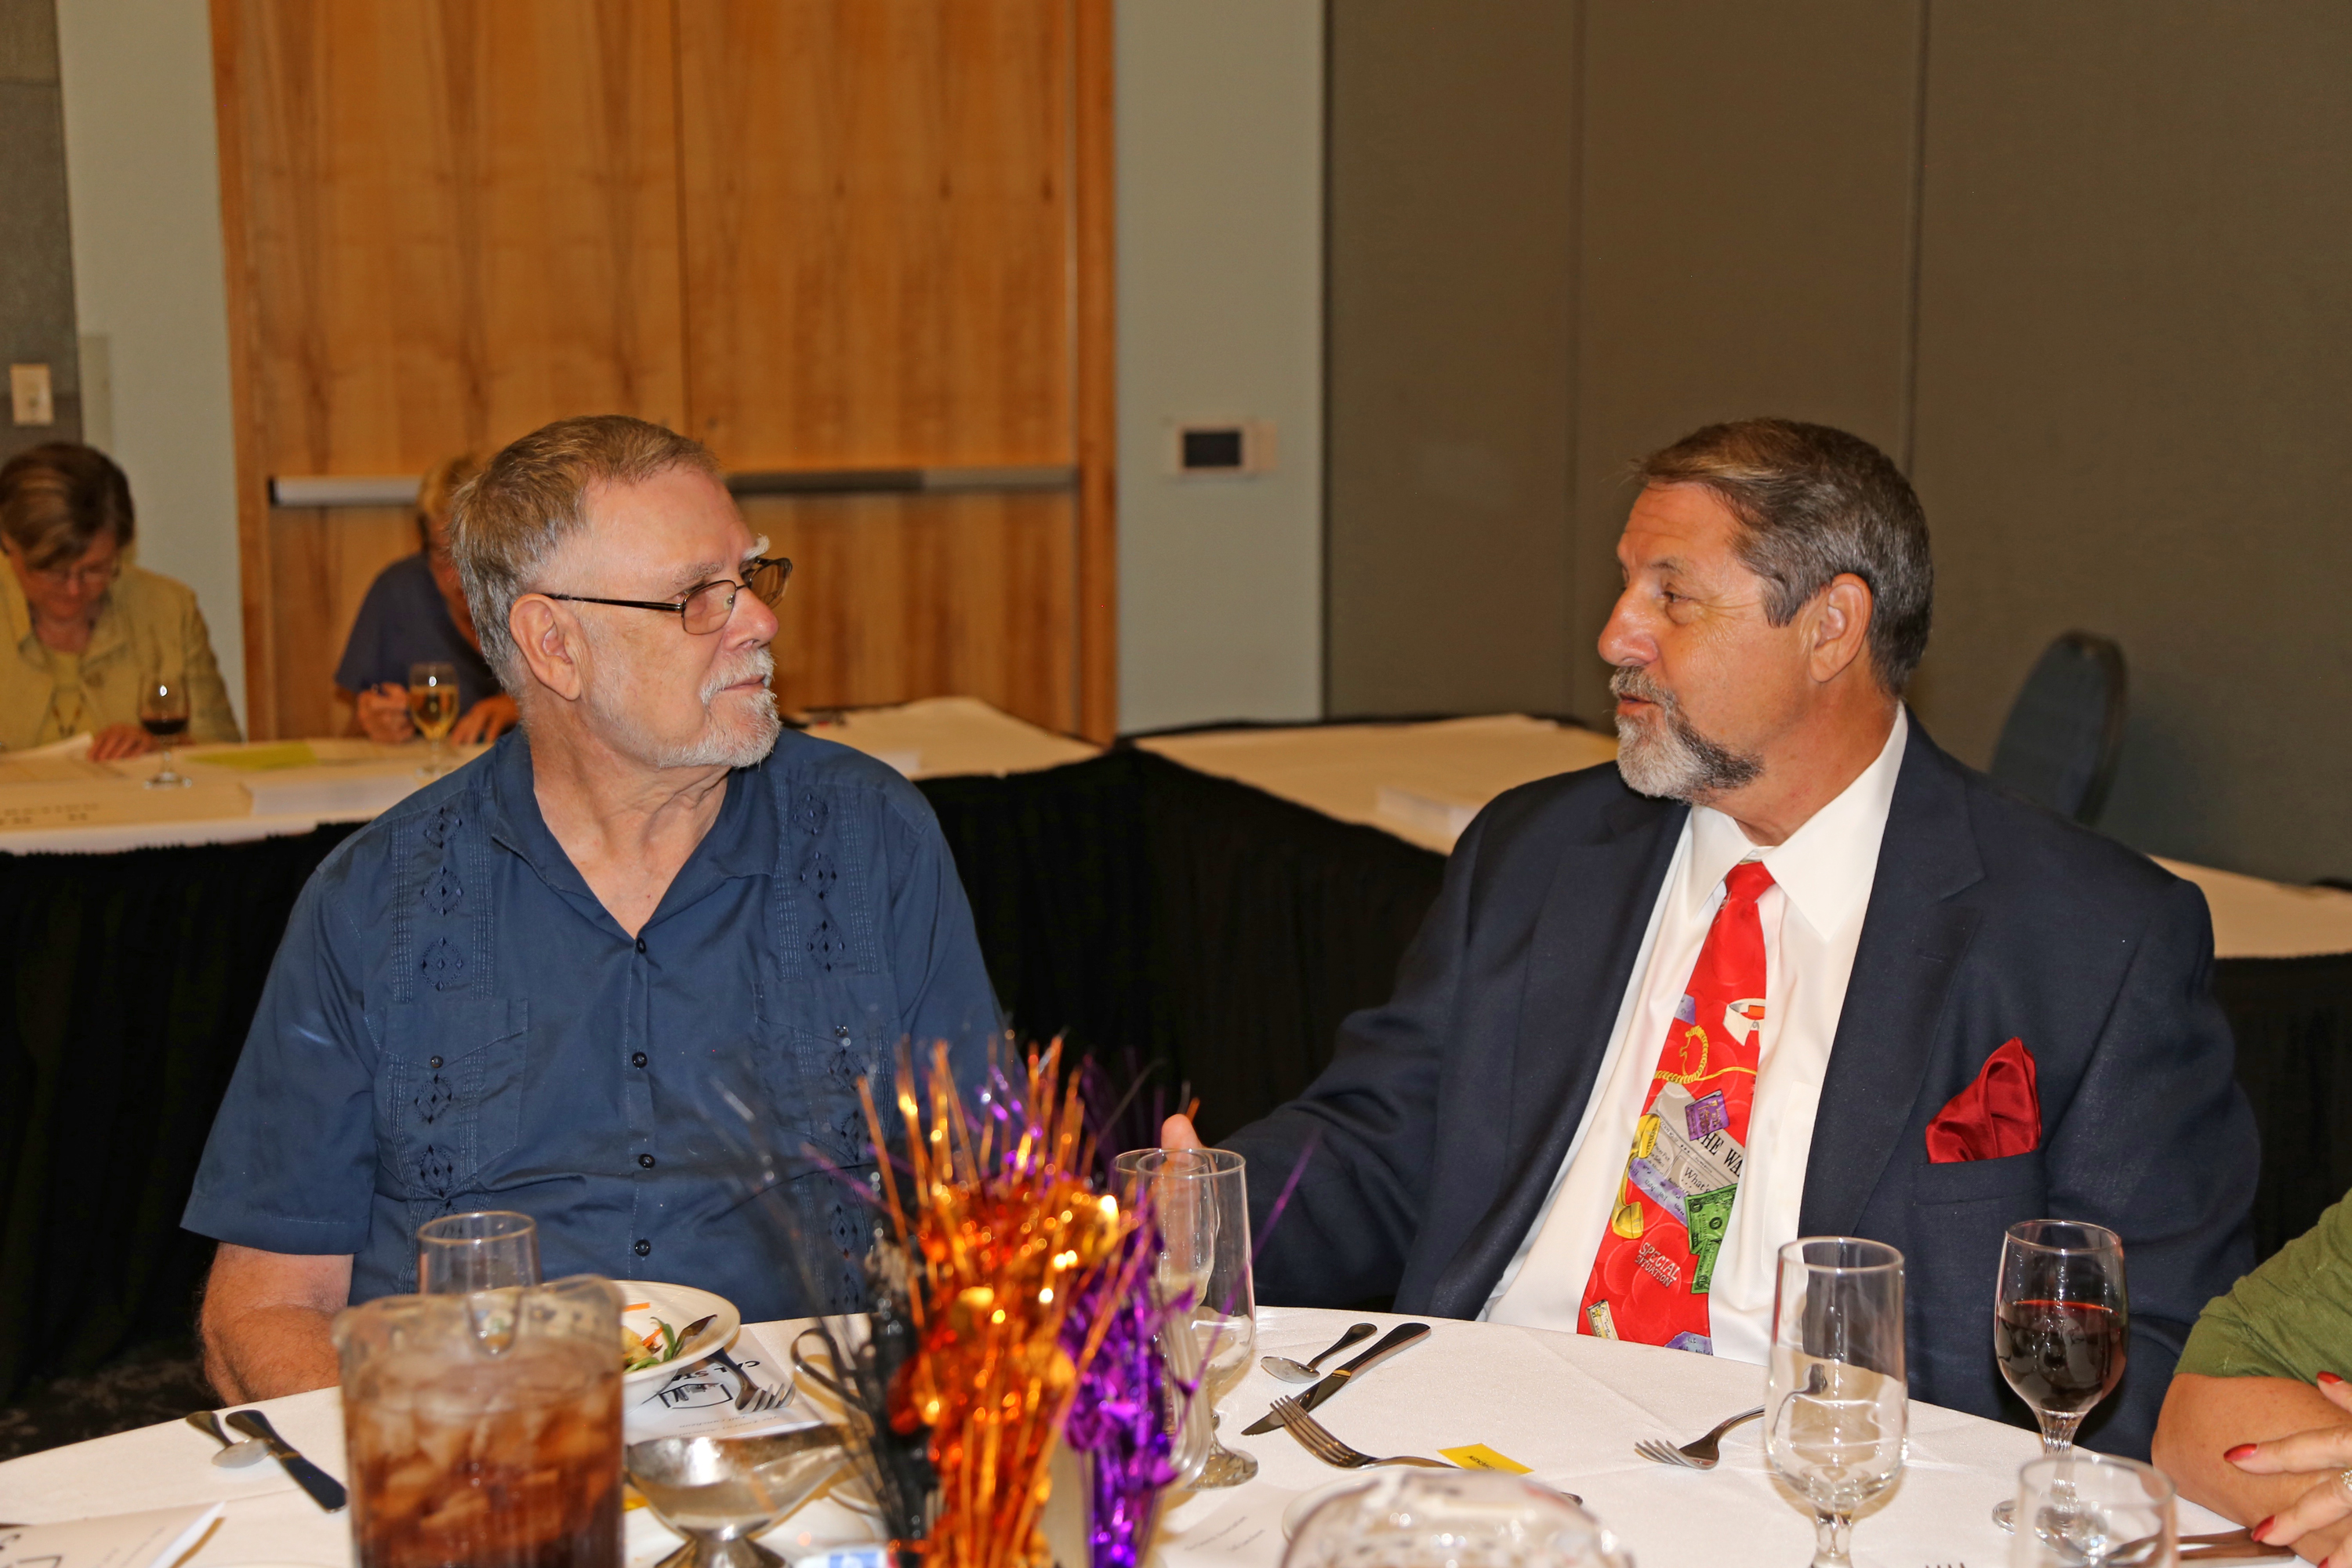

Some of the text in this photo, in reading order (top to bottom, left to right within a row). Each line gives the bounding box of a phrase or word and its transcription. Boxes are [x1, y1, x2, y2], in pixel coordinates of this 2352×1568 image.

[1697, 1132, 1724, 1156] HE
[1723, 1147, 1743, 1177] WA
[1635, 1254, 1673, 1287] SITUATION
[1639, 1242, 1681, 1281] SPECIAL
